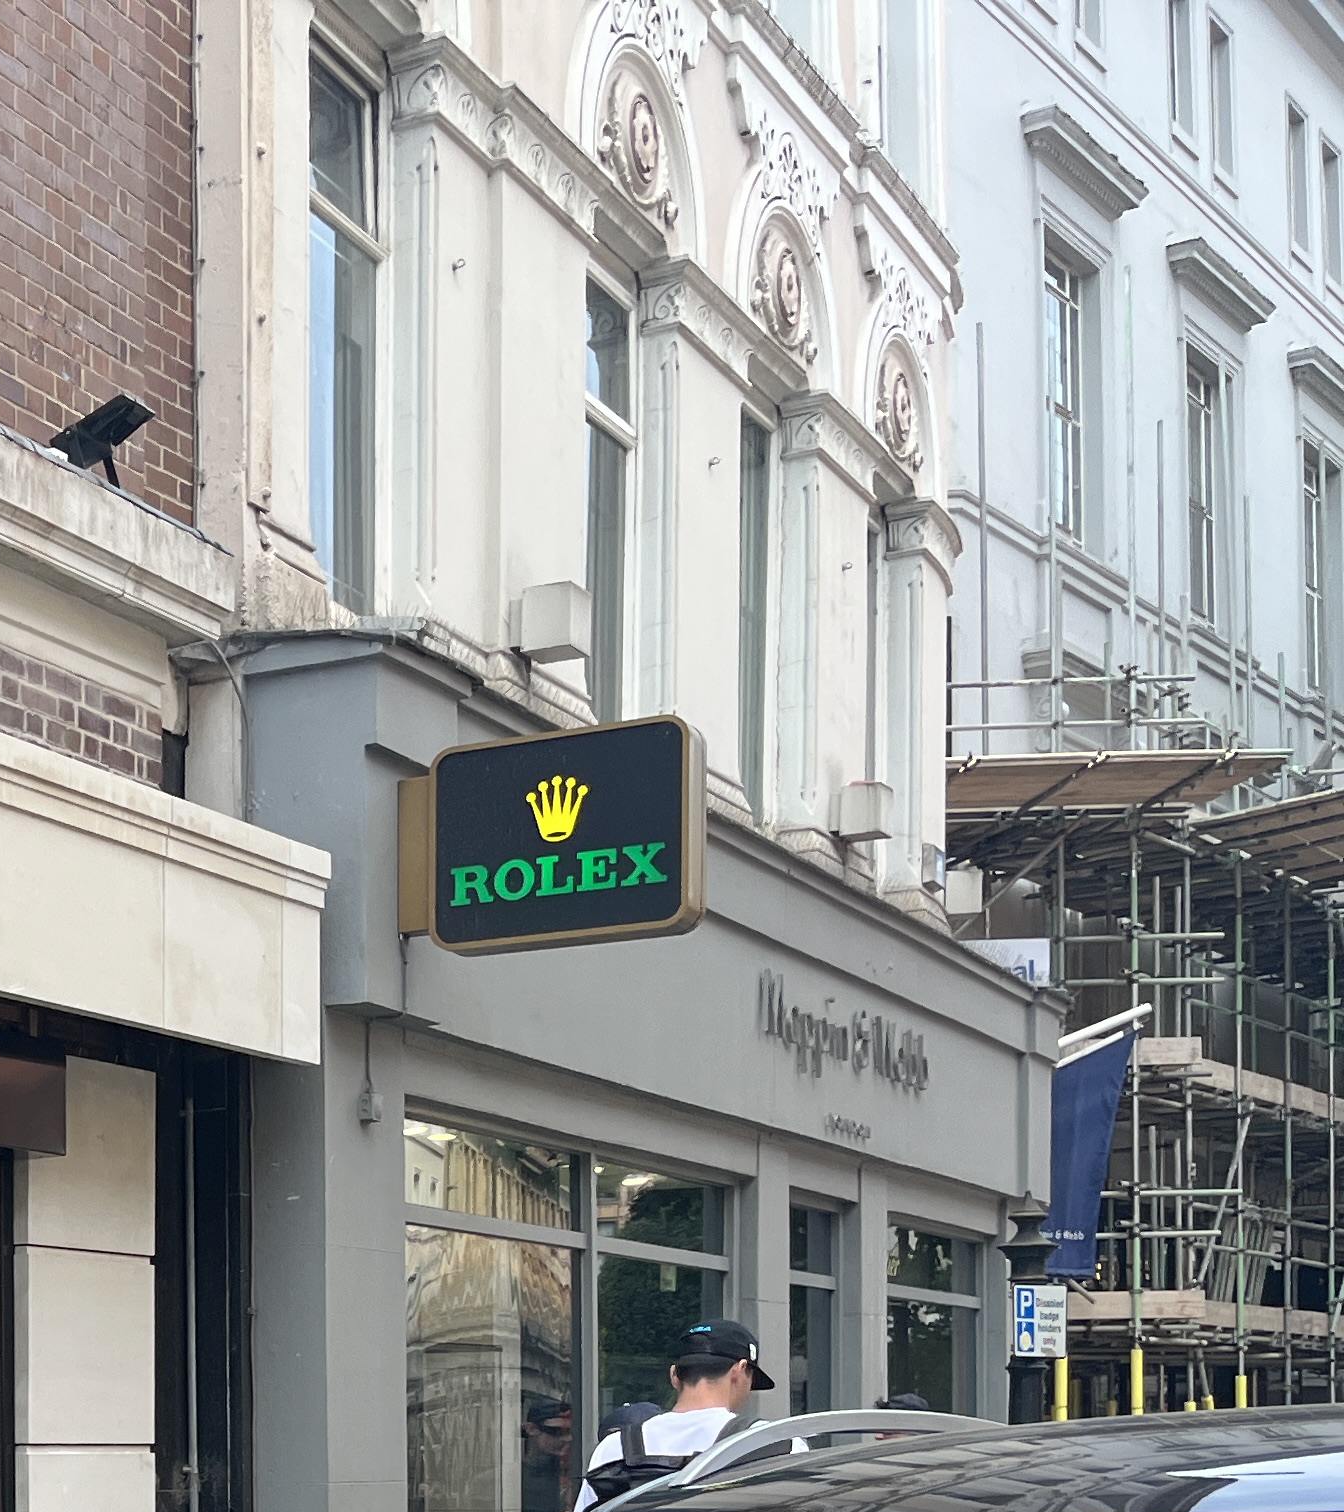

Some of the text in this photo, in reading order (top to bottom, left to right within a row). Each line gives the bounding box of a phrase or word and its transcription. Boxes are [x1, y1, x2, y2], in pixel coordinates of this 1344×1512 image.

[449, 841, 668, 908] ROLEX
[1020, 1290, 1033, 1317] P
[1039, 1310, 1060, 1322] badge
[1037, 1322, 1062, 1334] holders
[1042, 1336, 1057, 1348] only
